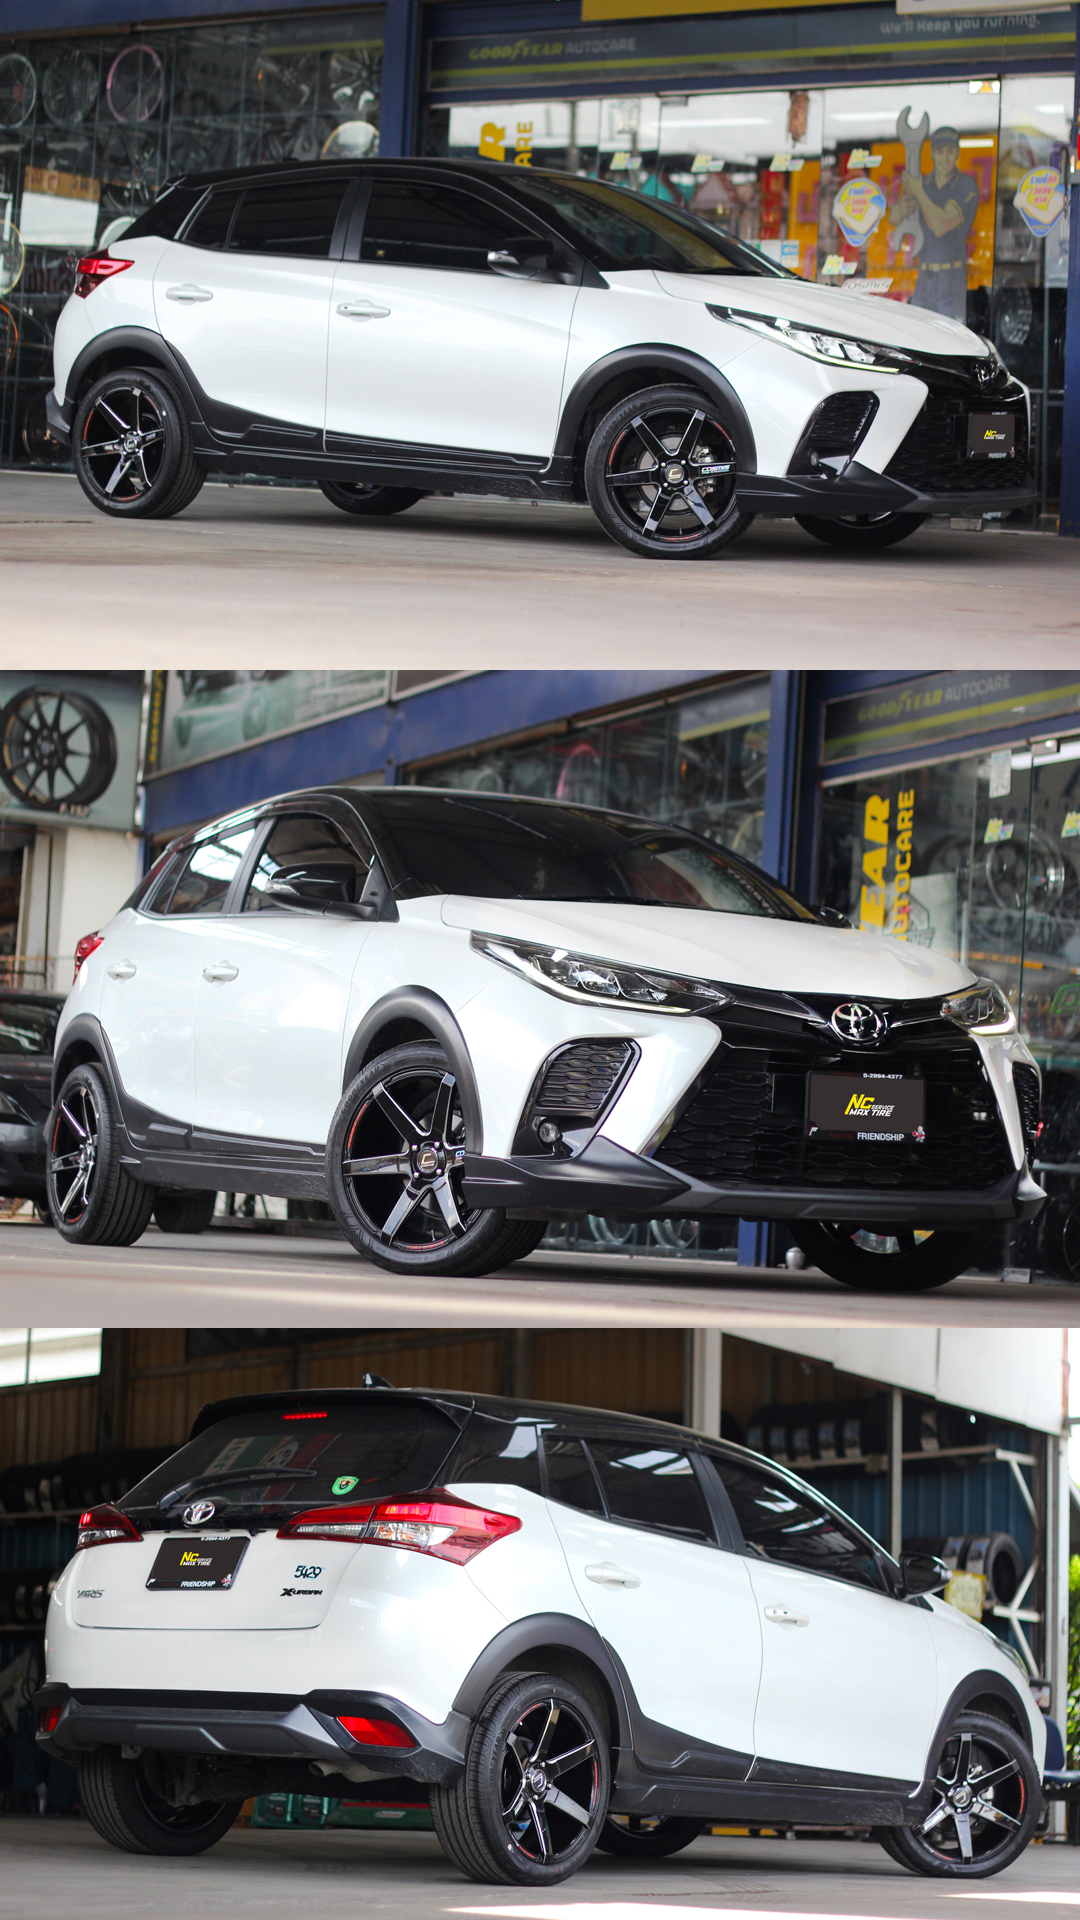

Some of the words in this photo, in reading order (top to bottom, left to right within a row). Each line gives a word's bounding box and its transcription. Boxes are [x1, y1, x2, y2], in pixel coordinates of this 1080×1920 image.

[468, 39, 564, 61] GOODYEAR
[564, 38, 636, 55] AUTOCARE
[857, 690, 944, 723] GOODYEAR
[944, 673, 1011, 702] AUTOCARE
[859, 795, 890, 932] EAR
[893, 789, 915, 942] UTOCARE
[857, 1132, 905, 1141] FRIENDSHIP
[294, 1565, 322, 1579] 5429
